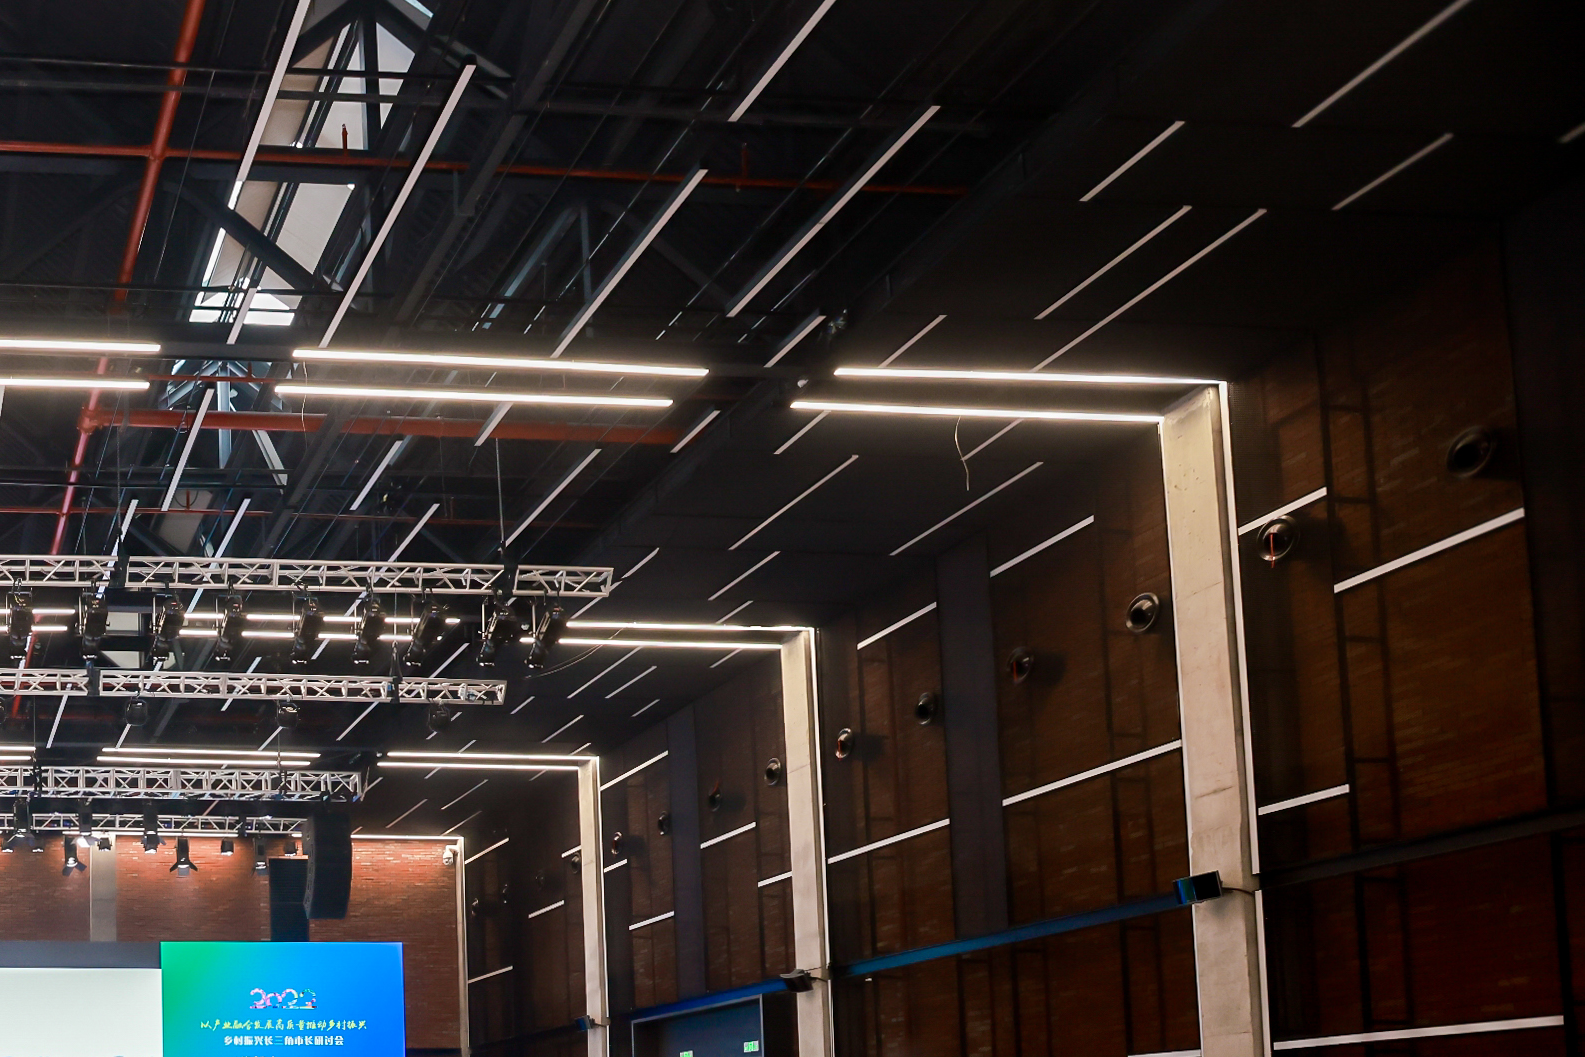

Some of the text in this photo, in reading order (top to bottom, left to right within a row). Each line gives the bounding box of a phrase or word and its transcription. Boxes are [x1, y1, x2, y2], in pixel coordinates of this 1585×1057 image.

[249, 987, 317, 1010] 2022
[224, 1035, 344, 1046] 乡村振兴长三角市长研讨会
